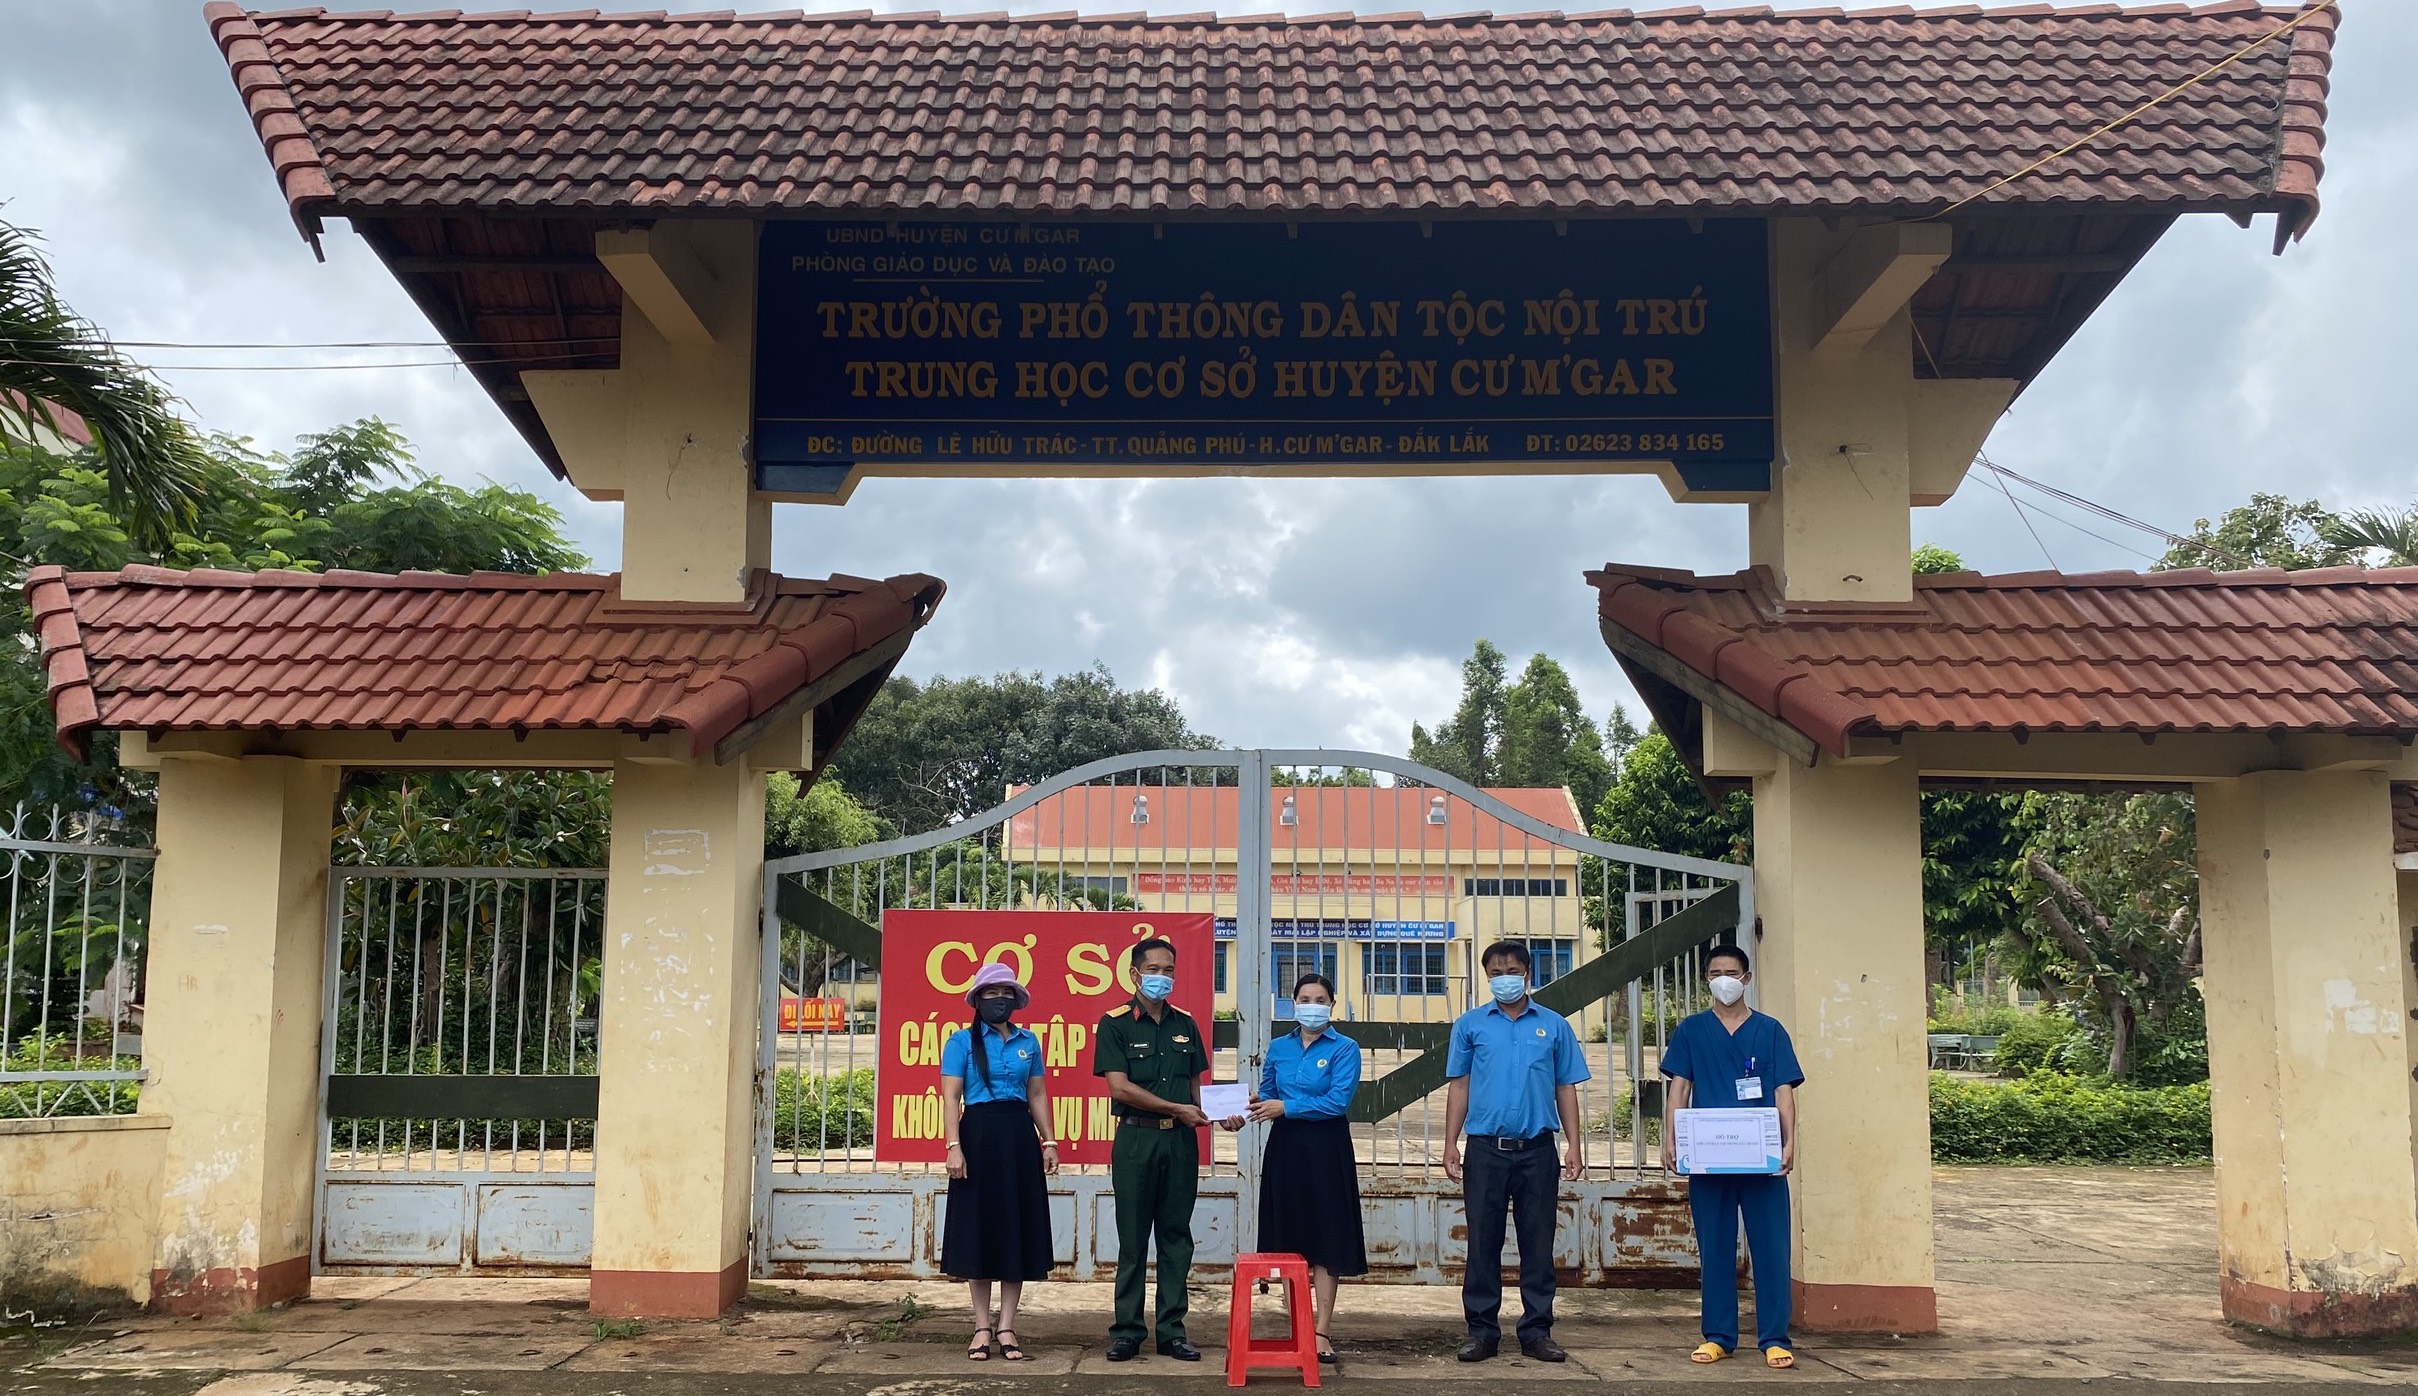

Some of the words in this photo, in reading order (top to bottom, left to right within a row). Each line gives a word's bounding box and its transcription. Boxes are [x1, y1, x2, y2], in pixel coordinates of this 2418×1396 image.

[827, 228, 883, 243] UBND
[895, 225, 968, 246] HUYỆN
[980, 226, 1011, 244] CƯ
[792, 252, 866, 273] PHÒNG
[873, 252, 925, 274] GIÁO
[933, 256, 976, 277] DỤC
[988, 251, 1012, 273] VÀ
[1023, 251, 1067, 273] ĐÀO
[1075, 256, 1115, 277] TẠO
[817, 286, 1002, 339] TRƯỜNG
[1018, 280, 1109, 339] PHỔ
[1126, 291, 1284, 339] THÔNG
[1300, 289, 1400, 338] DÂN
[1415, 289, 1506, 346] TỘC
[1523, 288, 1600, 345] NỘI
[1615, 285, 1708, 337] TRÚ
[845, 360, 998, 399] TRUNG
[1014, 360, 1109, 406] HỌC
[1124, 354, 1187, 399] CƠ
[1200, 345, 1257, 399] SỞ
[1273, 349, 1438, 406] HUYỆN
[1450, 354, 1516, 397] CƯ
[1521, 354, 1677, 397] M'GAR
[807, 436, 843, 454] ĐC:
[851, 430, 922, 454] ĐƯỜNG
[937, 431, 961, 454] LÊ
[971, 430, 1012, 454] HỮU
[1127, 430, 1197, 454] QUẢNG
[1205, 430, 1245, 454] PHÚ
[1398, 426, 1441, 453] ĐẮK
[1450, 426, 1490, 453] LẮK
[1526, 434, 1560, 453] ĐT:
[1565, 433, 1633, 453] 02623
[1639, 433, 1680, 453] 834
[1686, 432, 1724, 452] 165
[1301, 928, 1316, 937] LẬP
[1052, 1096, 1083, 1151] VỤ
